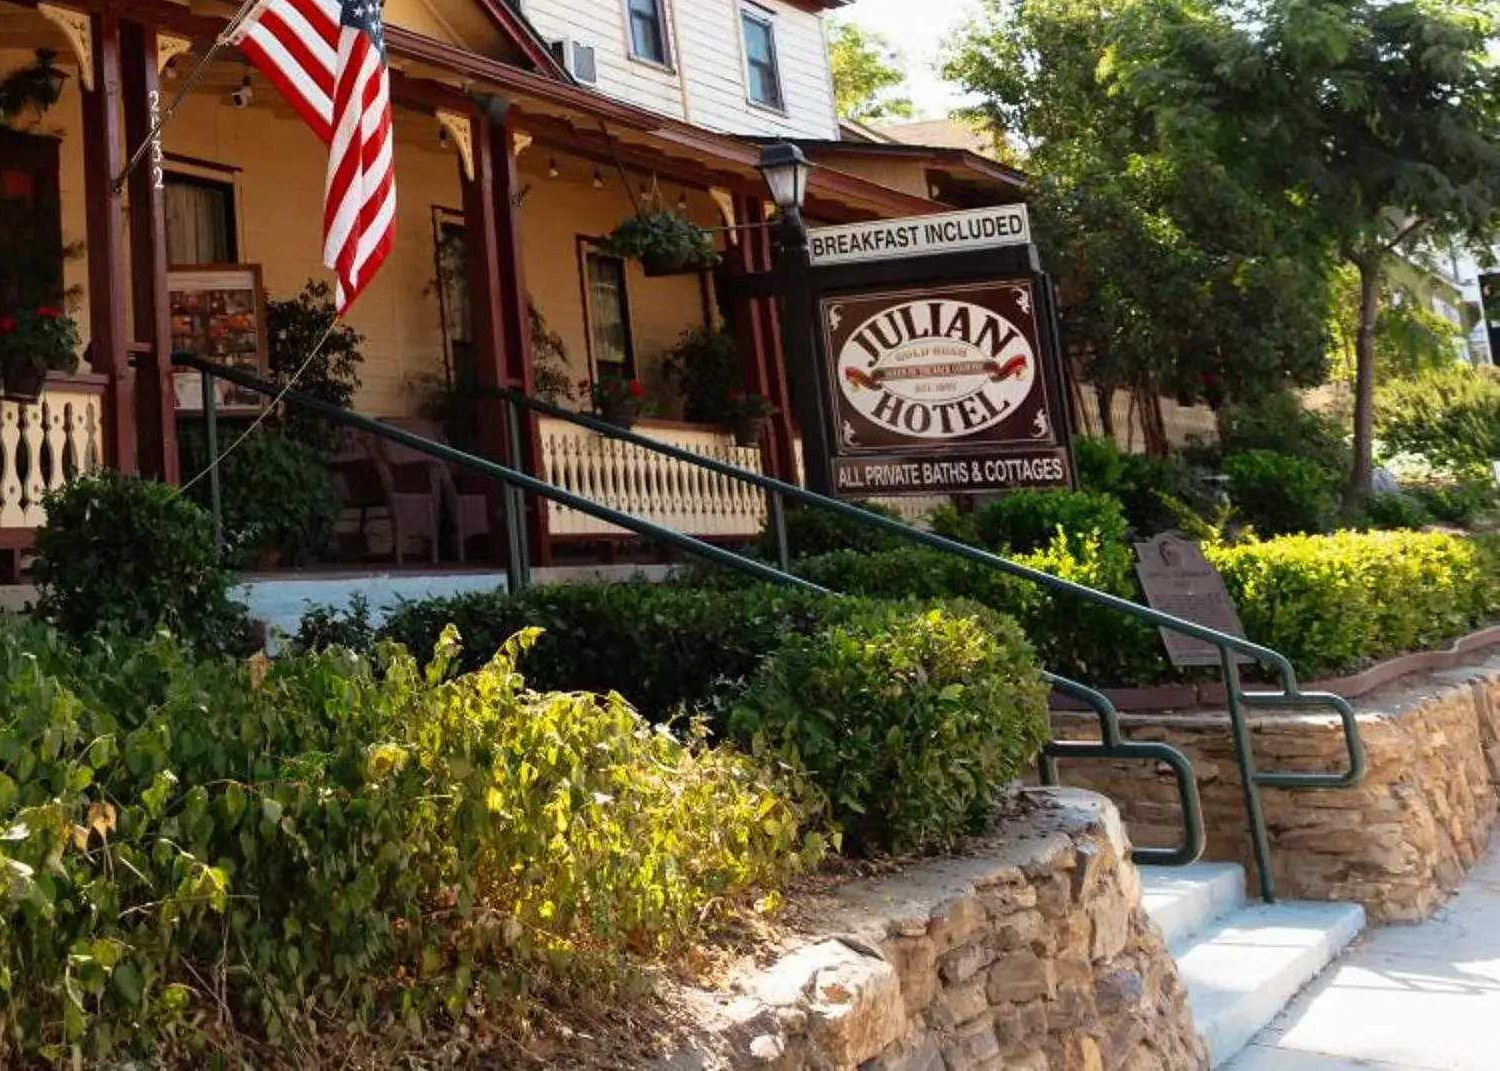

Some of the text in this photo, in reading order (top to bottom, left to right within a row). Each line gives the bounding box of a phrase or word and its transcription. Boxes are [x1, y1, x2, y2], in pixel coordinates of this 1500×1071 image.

[811, 214, 1023, 257] BREAKFAST INCLUDED
[851, 302, 1020, 367] JULIAN
[871, 390, 1011, 434] HOTEL
[838, 458, 1064, 488] ALL PRIVATE BATHS & COTTAGES
